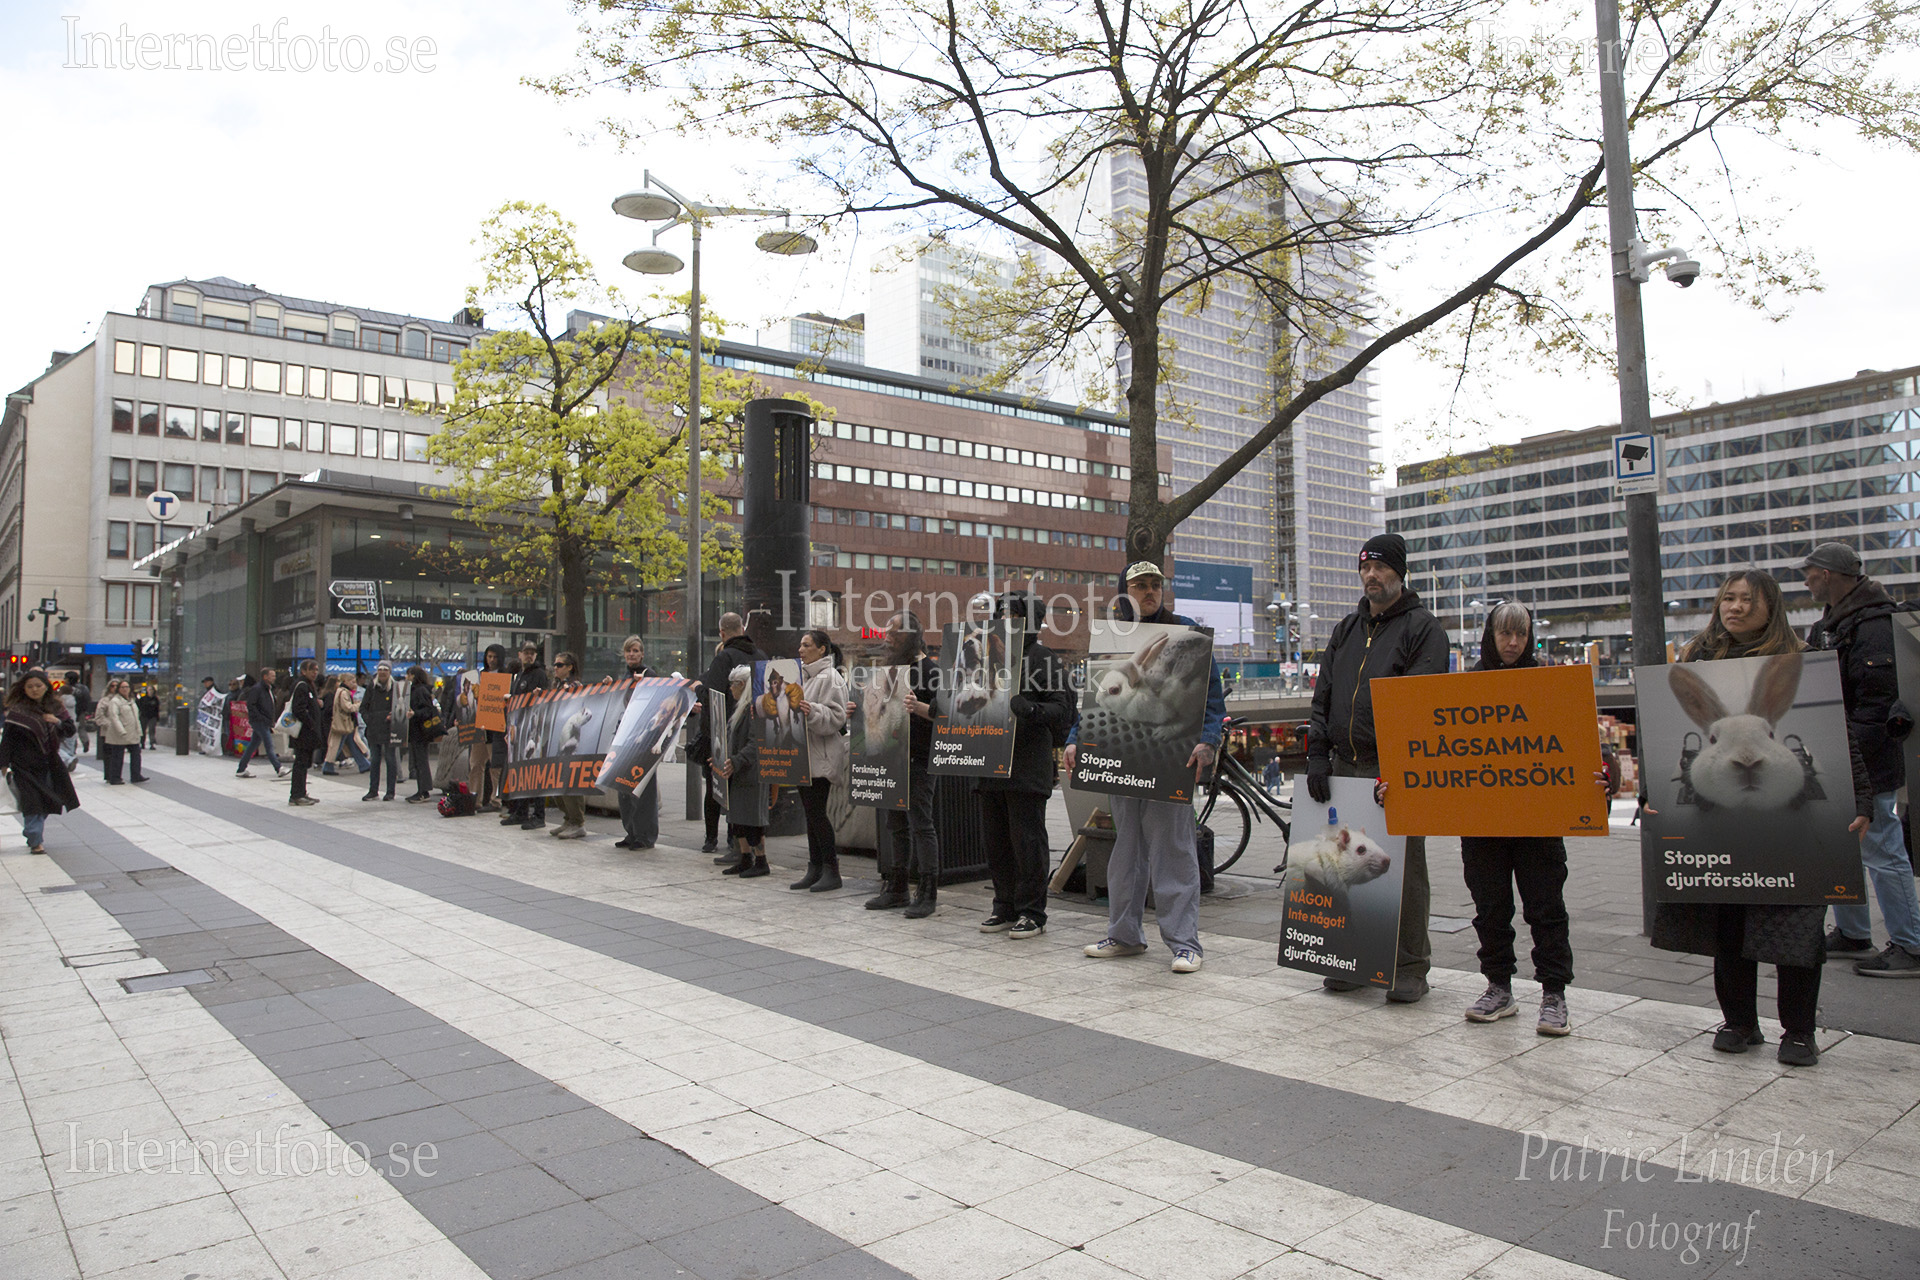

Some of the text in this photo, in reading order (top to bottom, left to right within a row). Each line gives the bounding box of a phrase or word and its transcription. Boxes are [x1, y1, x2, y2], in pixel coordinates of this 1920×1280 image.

[153, 496, 174, 516] T
[454, 609, 525, 626] Stockholm City
[1433, 704, 1528, 726] STOPPA
[937, 724, 950, 735] Var
[951, 724, 967, 735] inte
[967, 725, 1004, 738] hjärtlösa
[934, 740, 962, 753] Stoppa
[1408, 734, 1564, 758] PLÅGSAMMA
[932, 754, 986, 767] djurförsöken!
[1080, 752, 1122, 769] Stoppa
[517, 762, 564, 792] ANIMAL
[851, 764, 888, 777] Forskning är
[1078, 769, 1156, 789] djurförsöken!
[1403, 762, 1576, 789] DJURFÖRSÖK!
[851, 776, 897, 788] ingen ursäkt för
[851, 788, 883, 802] djurplågeri
[1664, 850, 1732, 869] Stoppa
[1665, 872, 1796, 890] djurförsöken!
[1289, 889, 1333, 909] NÅGON
[1287, 907, 1346, 929] Inte något!
[1286, 927, 1325, 947] Stoppa
[1284, 945, 1357, 972] djurförsöken!
